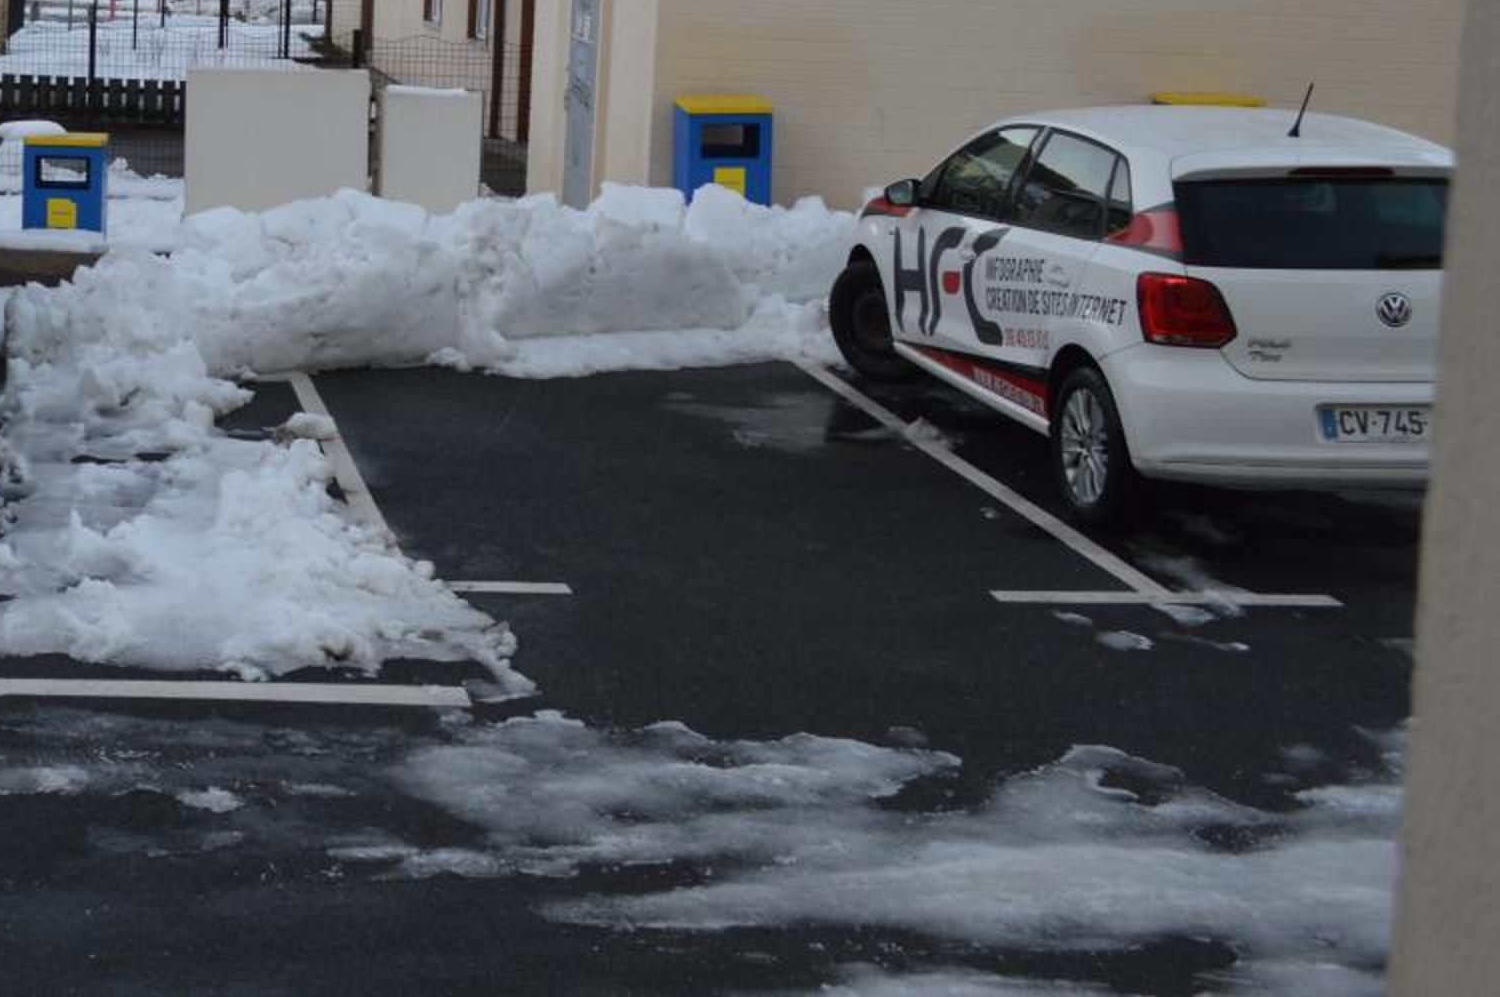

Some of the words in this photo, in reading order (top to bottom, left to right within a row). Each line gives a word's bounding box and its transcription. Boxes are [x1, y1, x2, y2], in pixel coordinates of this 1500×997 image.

[1028, 290, 1040, 315] DE
[1041, 290, 1069, 317] SITES
[1067, 293, 1127, 326] INTERNET
